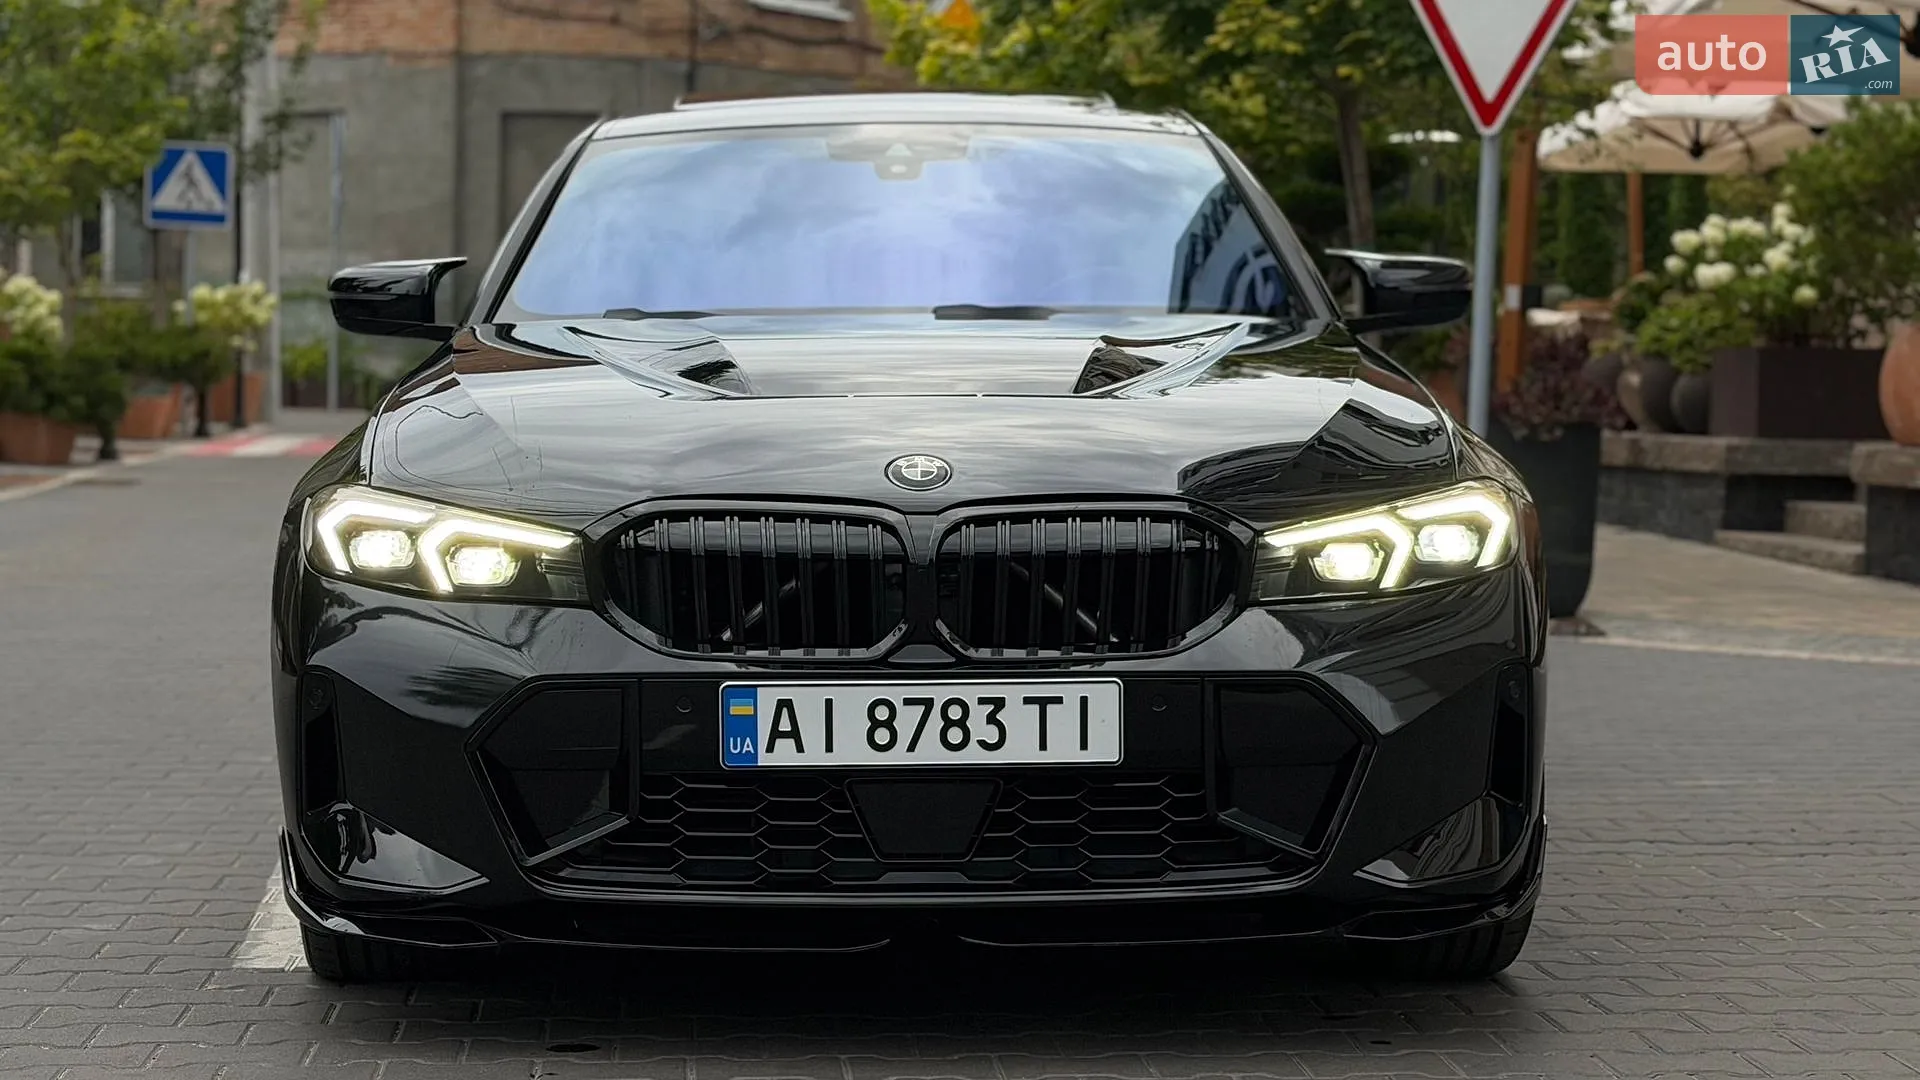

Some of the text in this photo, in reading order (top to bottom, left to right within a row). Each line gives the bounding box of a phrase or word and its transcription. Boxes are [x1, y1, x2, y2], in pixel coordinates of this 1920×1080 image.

[765, 696, 1088, 753] AI 8783 TI
[729, 737, 755, 754] UA
